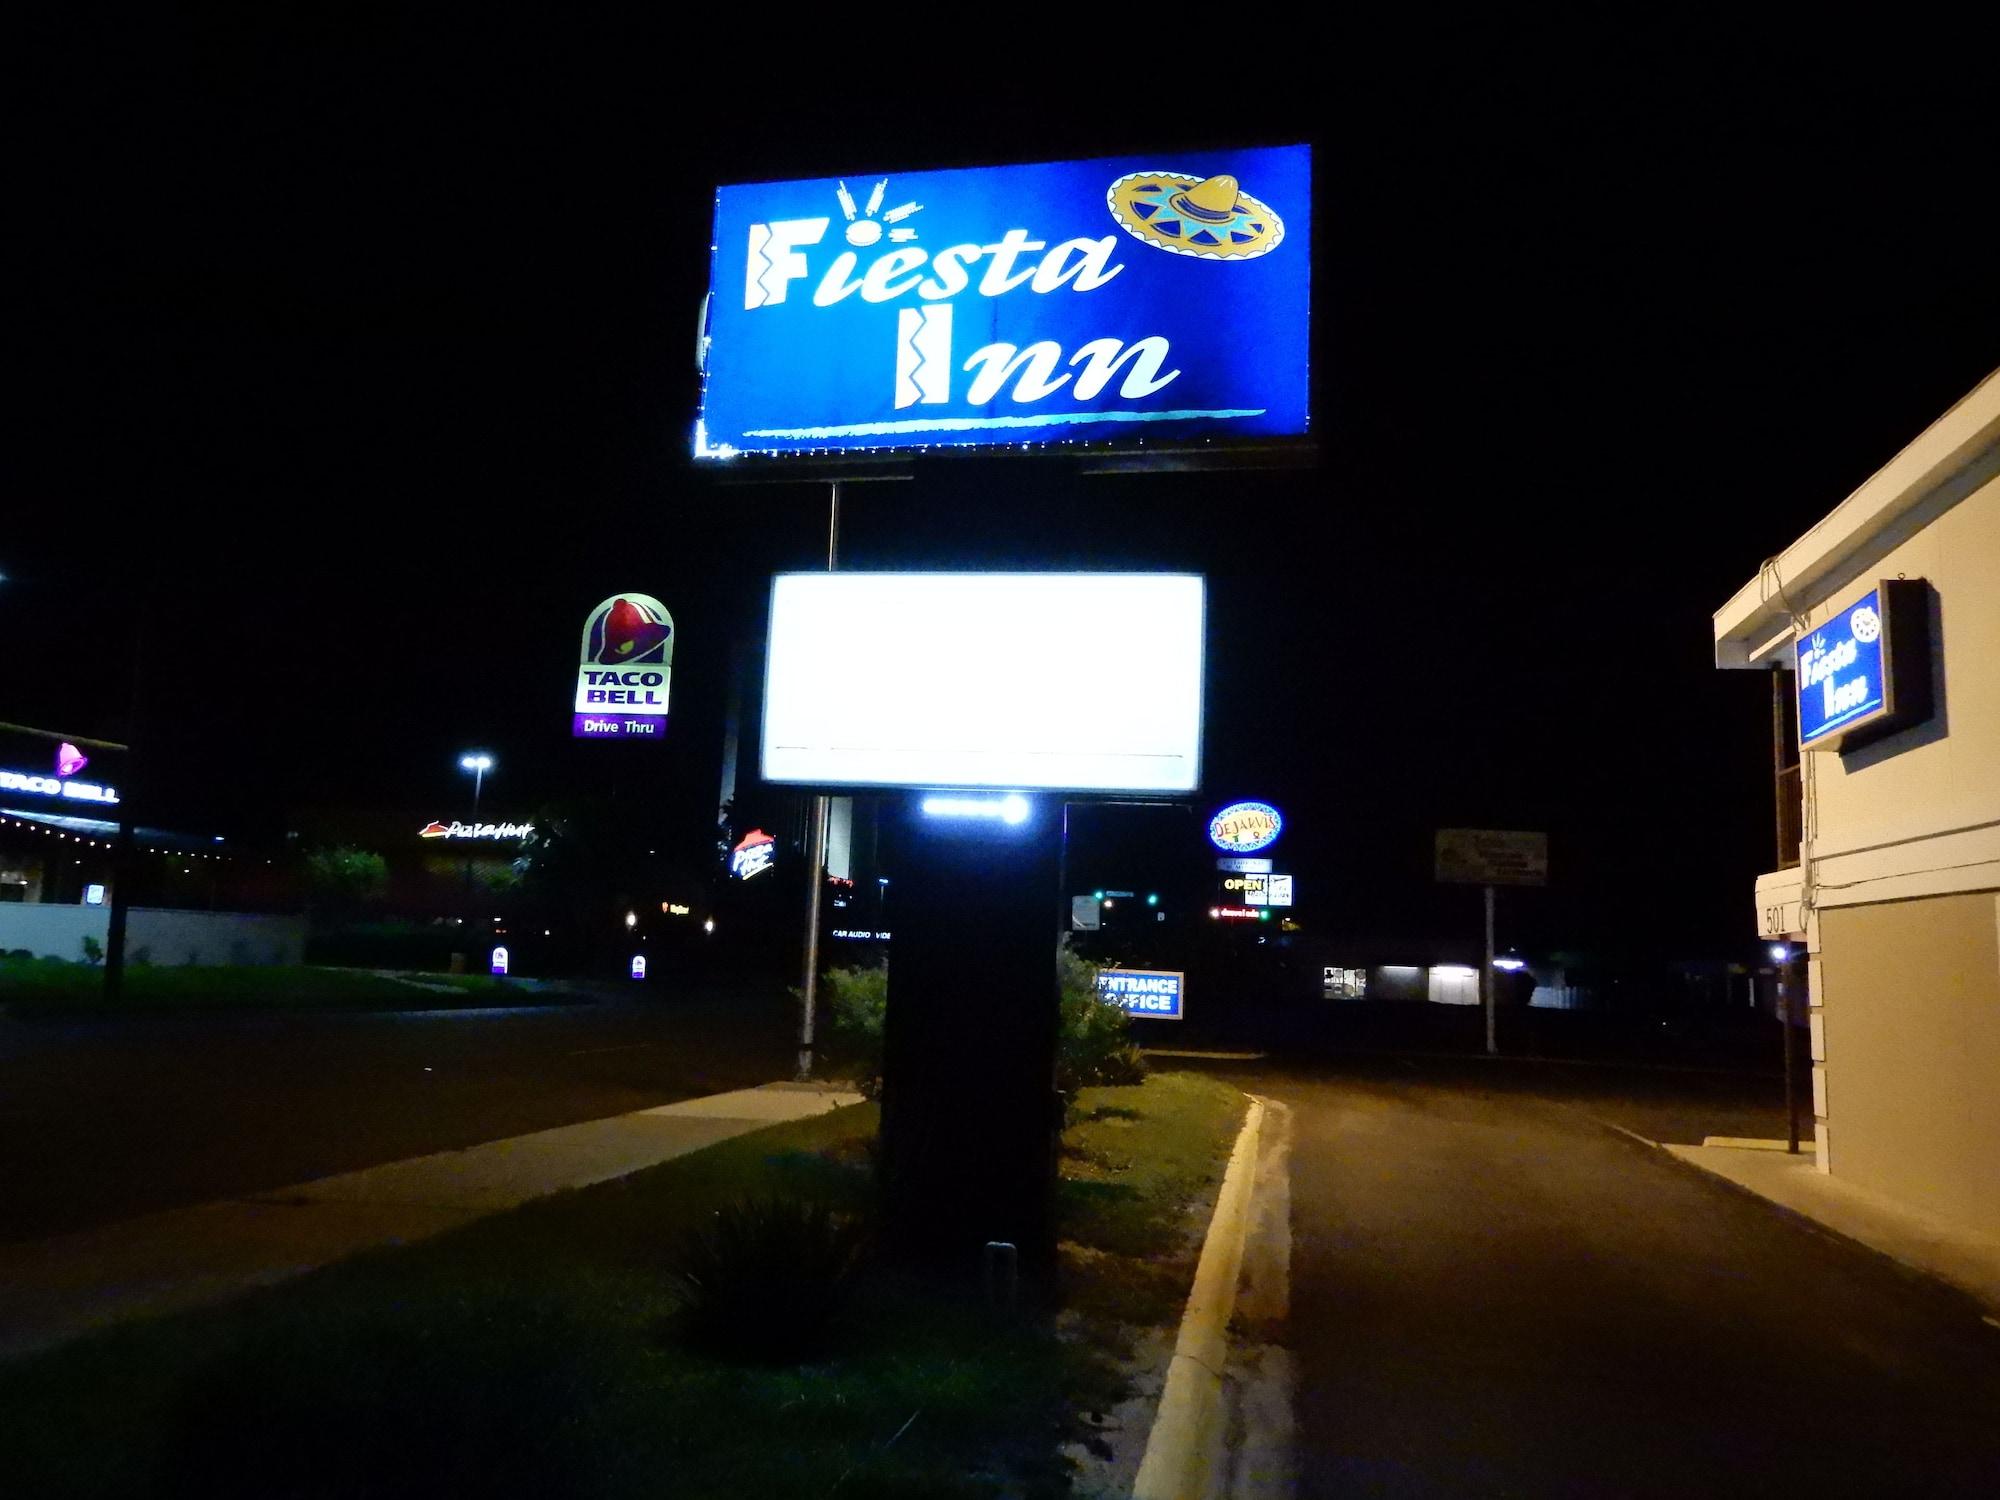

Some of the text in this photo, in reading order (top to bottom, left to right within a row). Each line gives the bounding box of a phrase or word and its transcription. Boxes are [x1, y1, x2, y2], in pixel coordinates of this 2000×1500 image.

[745, 213, 1127, 310] Fiesta
[894, 303, 1181, 410] Inn
[1800, 638, 1858, 690] Fiesta
[584, 672, 664, 687] TACO
[587, 690, 663, 705] BELL
[1823, 675, 1868, 720] Inn
[584, 719, 655, 734] Drive Thru
[1224, 878, 1263, 891] OPEN
[1766, 905, 1786, 934] 501
[833, 929, 848, 938] CAR
[848, 930, 872, 939] AUDIO
